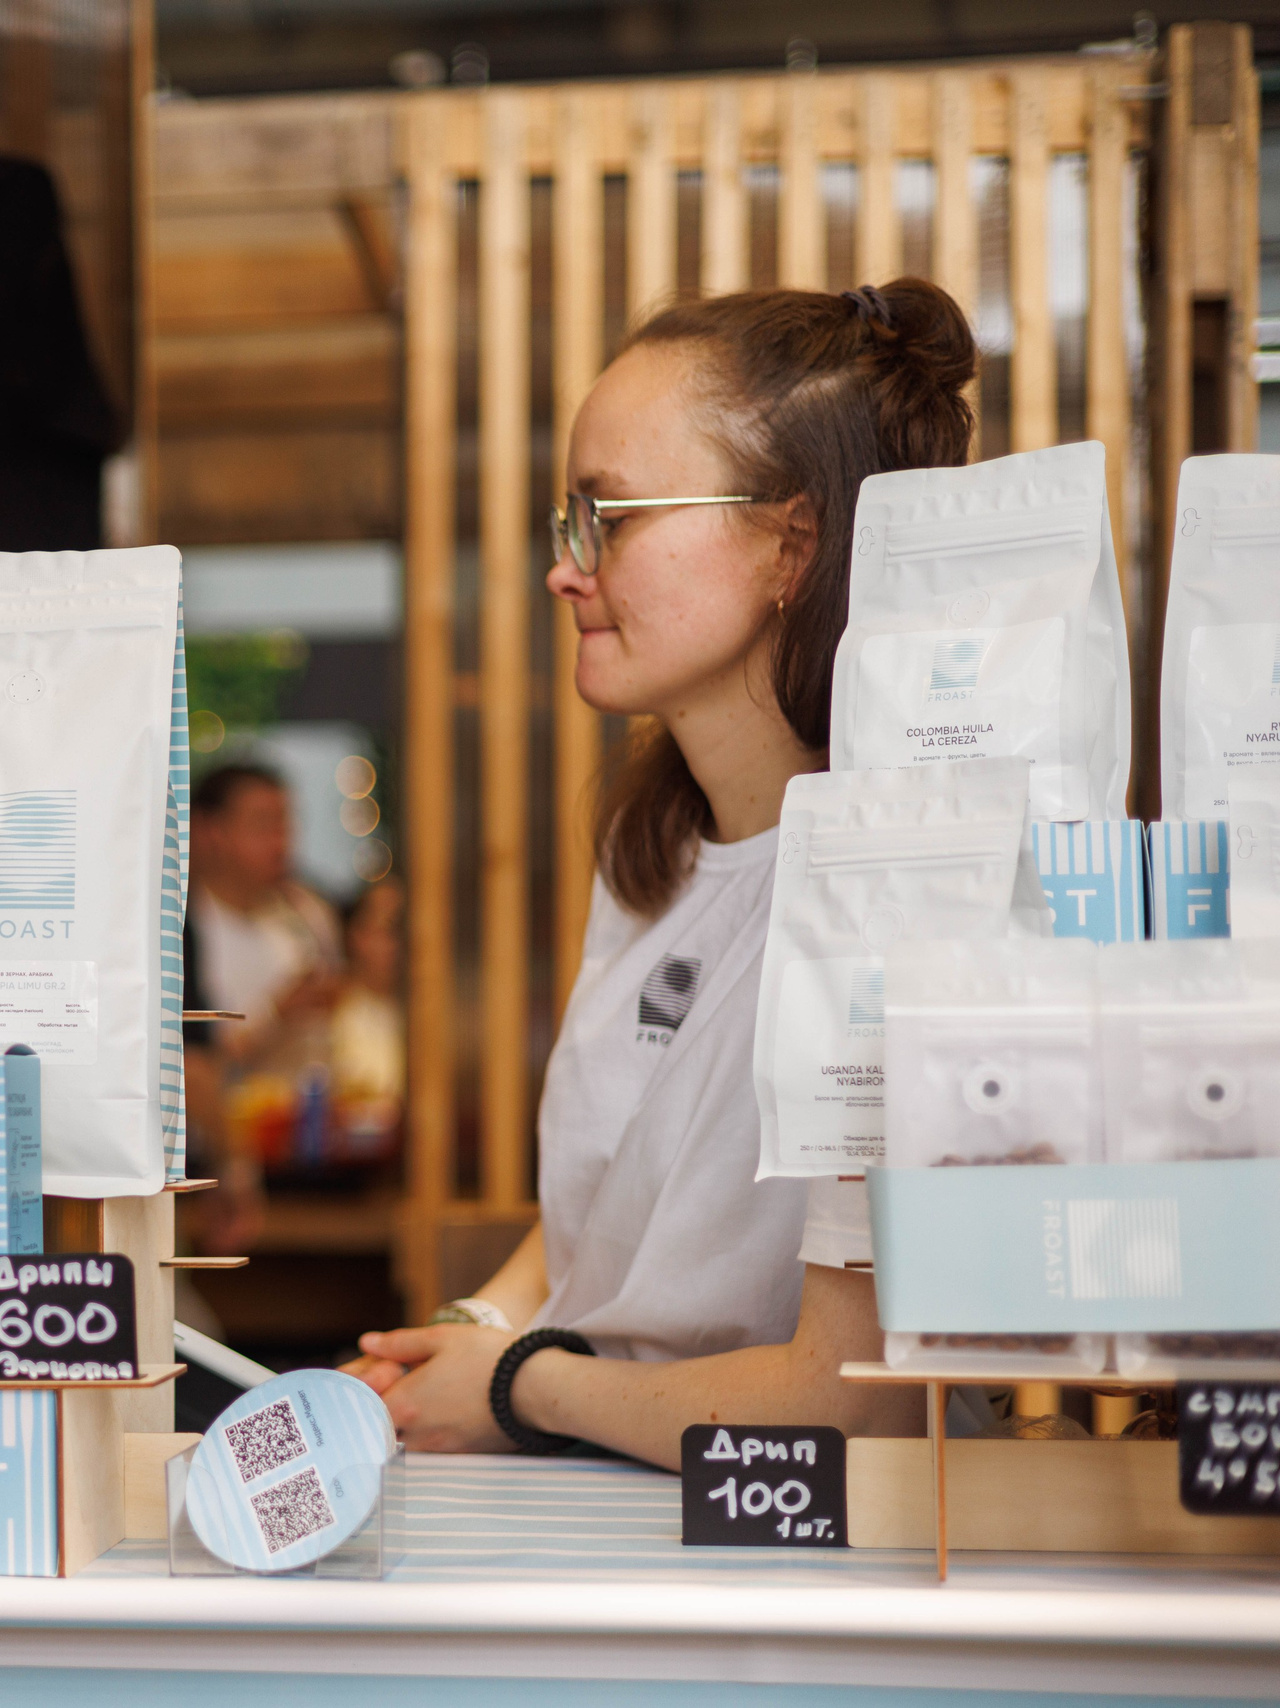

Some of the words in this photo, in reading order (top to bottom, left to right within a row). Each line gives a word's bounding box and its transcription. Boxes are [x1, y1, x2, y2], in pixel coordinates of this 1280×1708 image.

[928, 690, 975, 702] FROAST
[906, 725, 960, 738] COLOMBIA
[962, 723, 994, 734] HUILA
[922, 737, 935, 747] LA
[937, 735, 977, 746] CEREZA
[17, 982, 41, 990] LIMU
[44, 982, 66, 990] GR.2
[821, 1065, 863, 1075] UGANDA
[1042, 1199, 1066, 1299] FROAST
[703, 1428, 816, 1466] Дрип
[708, 1477, 812, 1519] 100
[776, 1517, 792, 1539] 1
